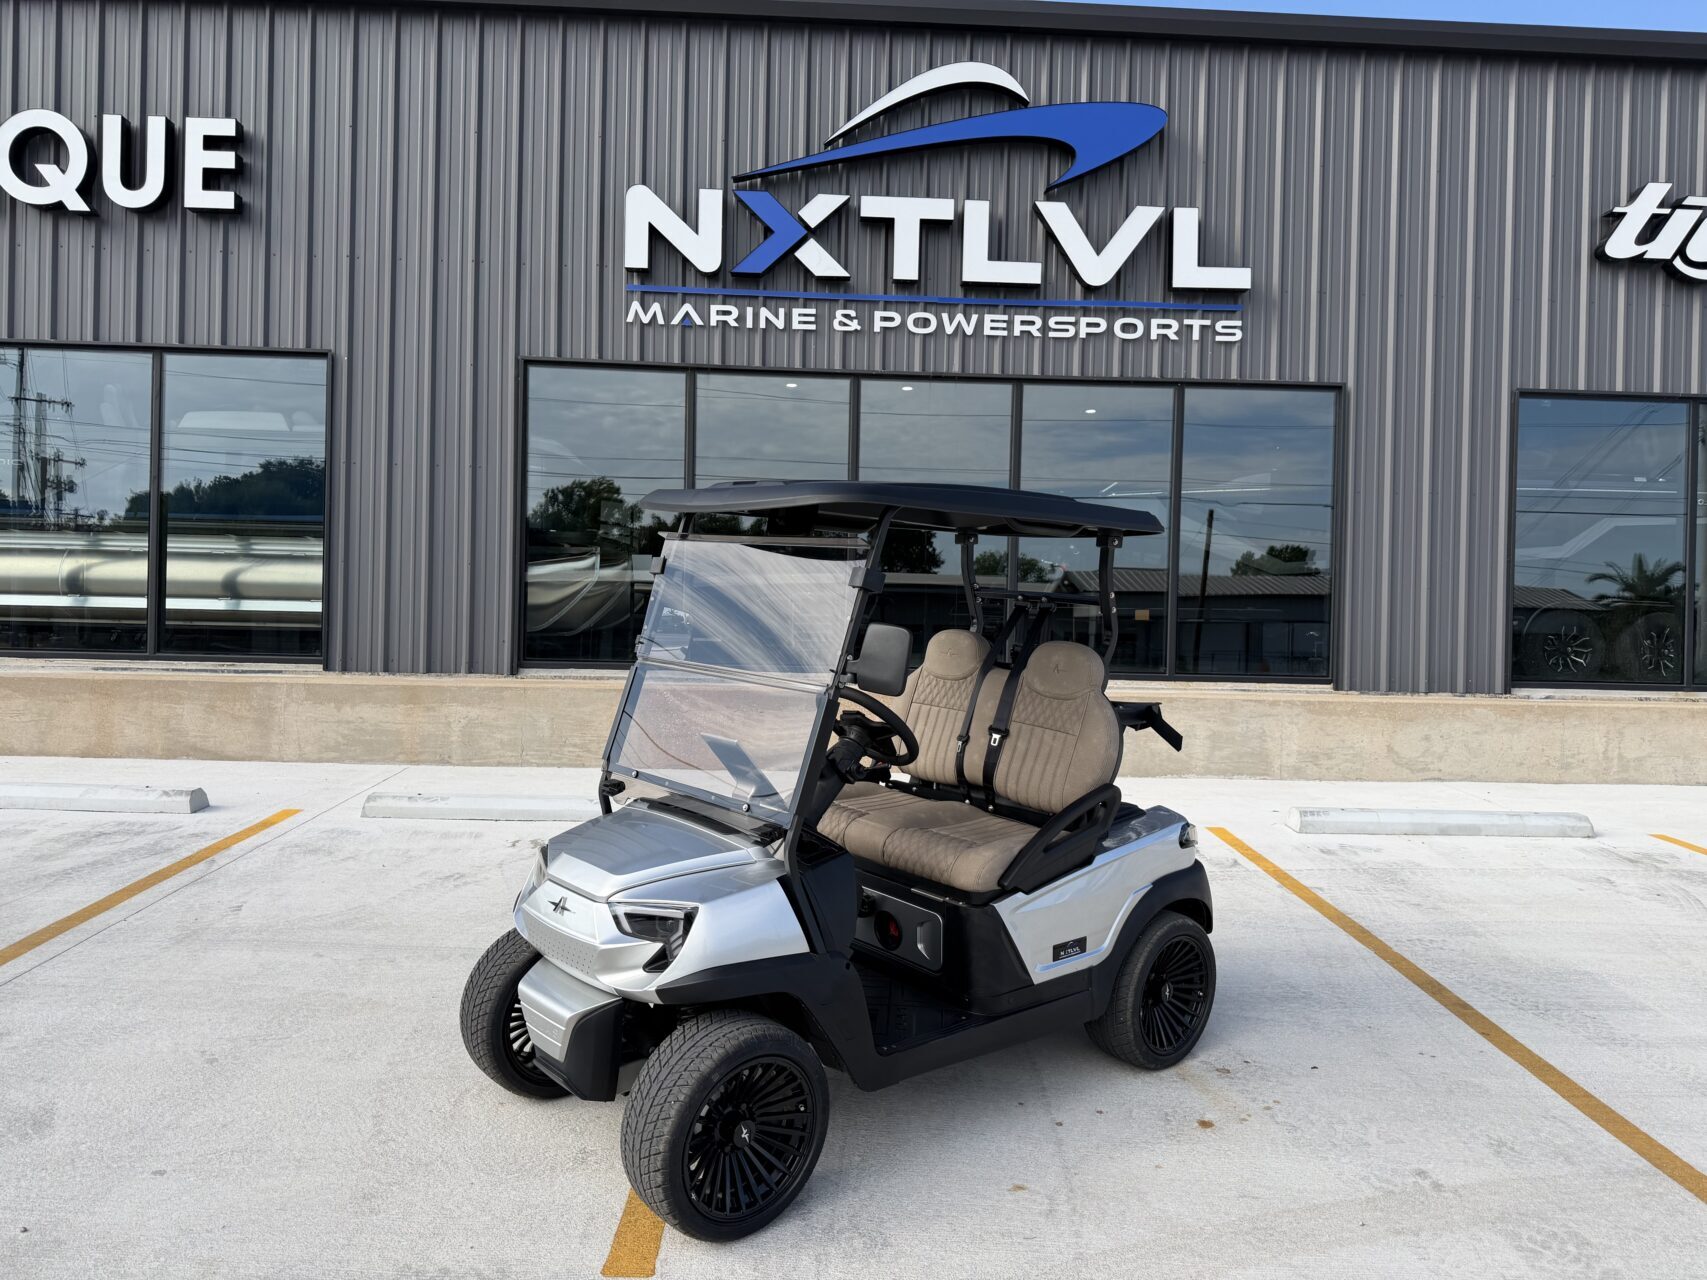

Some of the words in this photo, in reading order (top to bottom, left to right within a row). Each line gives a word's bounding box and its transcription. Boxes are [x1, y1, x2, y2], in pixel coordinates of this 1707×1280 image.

[0, 109, 236, 211] QUE
[625, 184, 1252, 290] NXTLVL
[626, 301, 817, 331] MARINE
[833, 309, 861, 331] &
[873, 310, 1243, 342] POWERSPORTS
